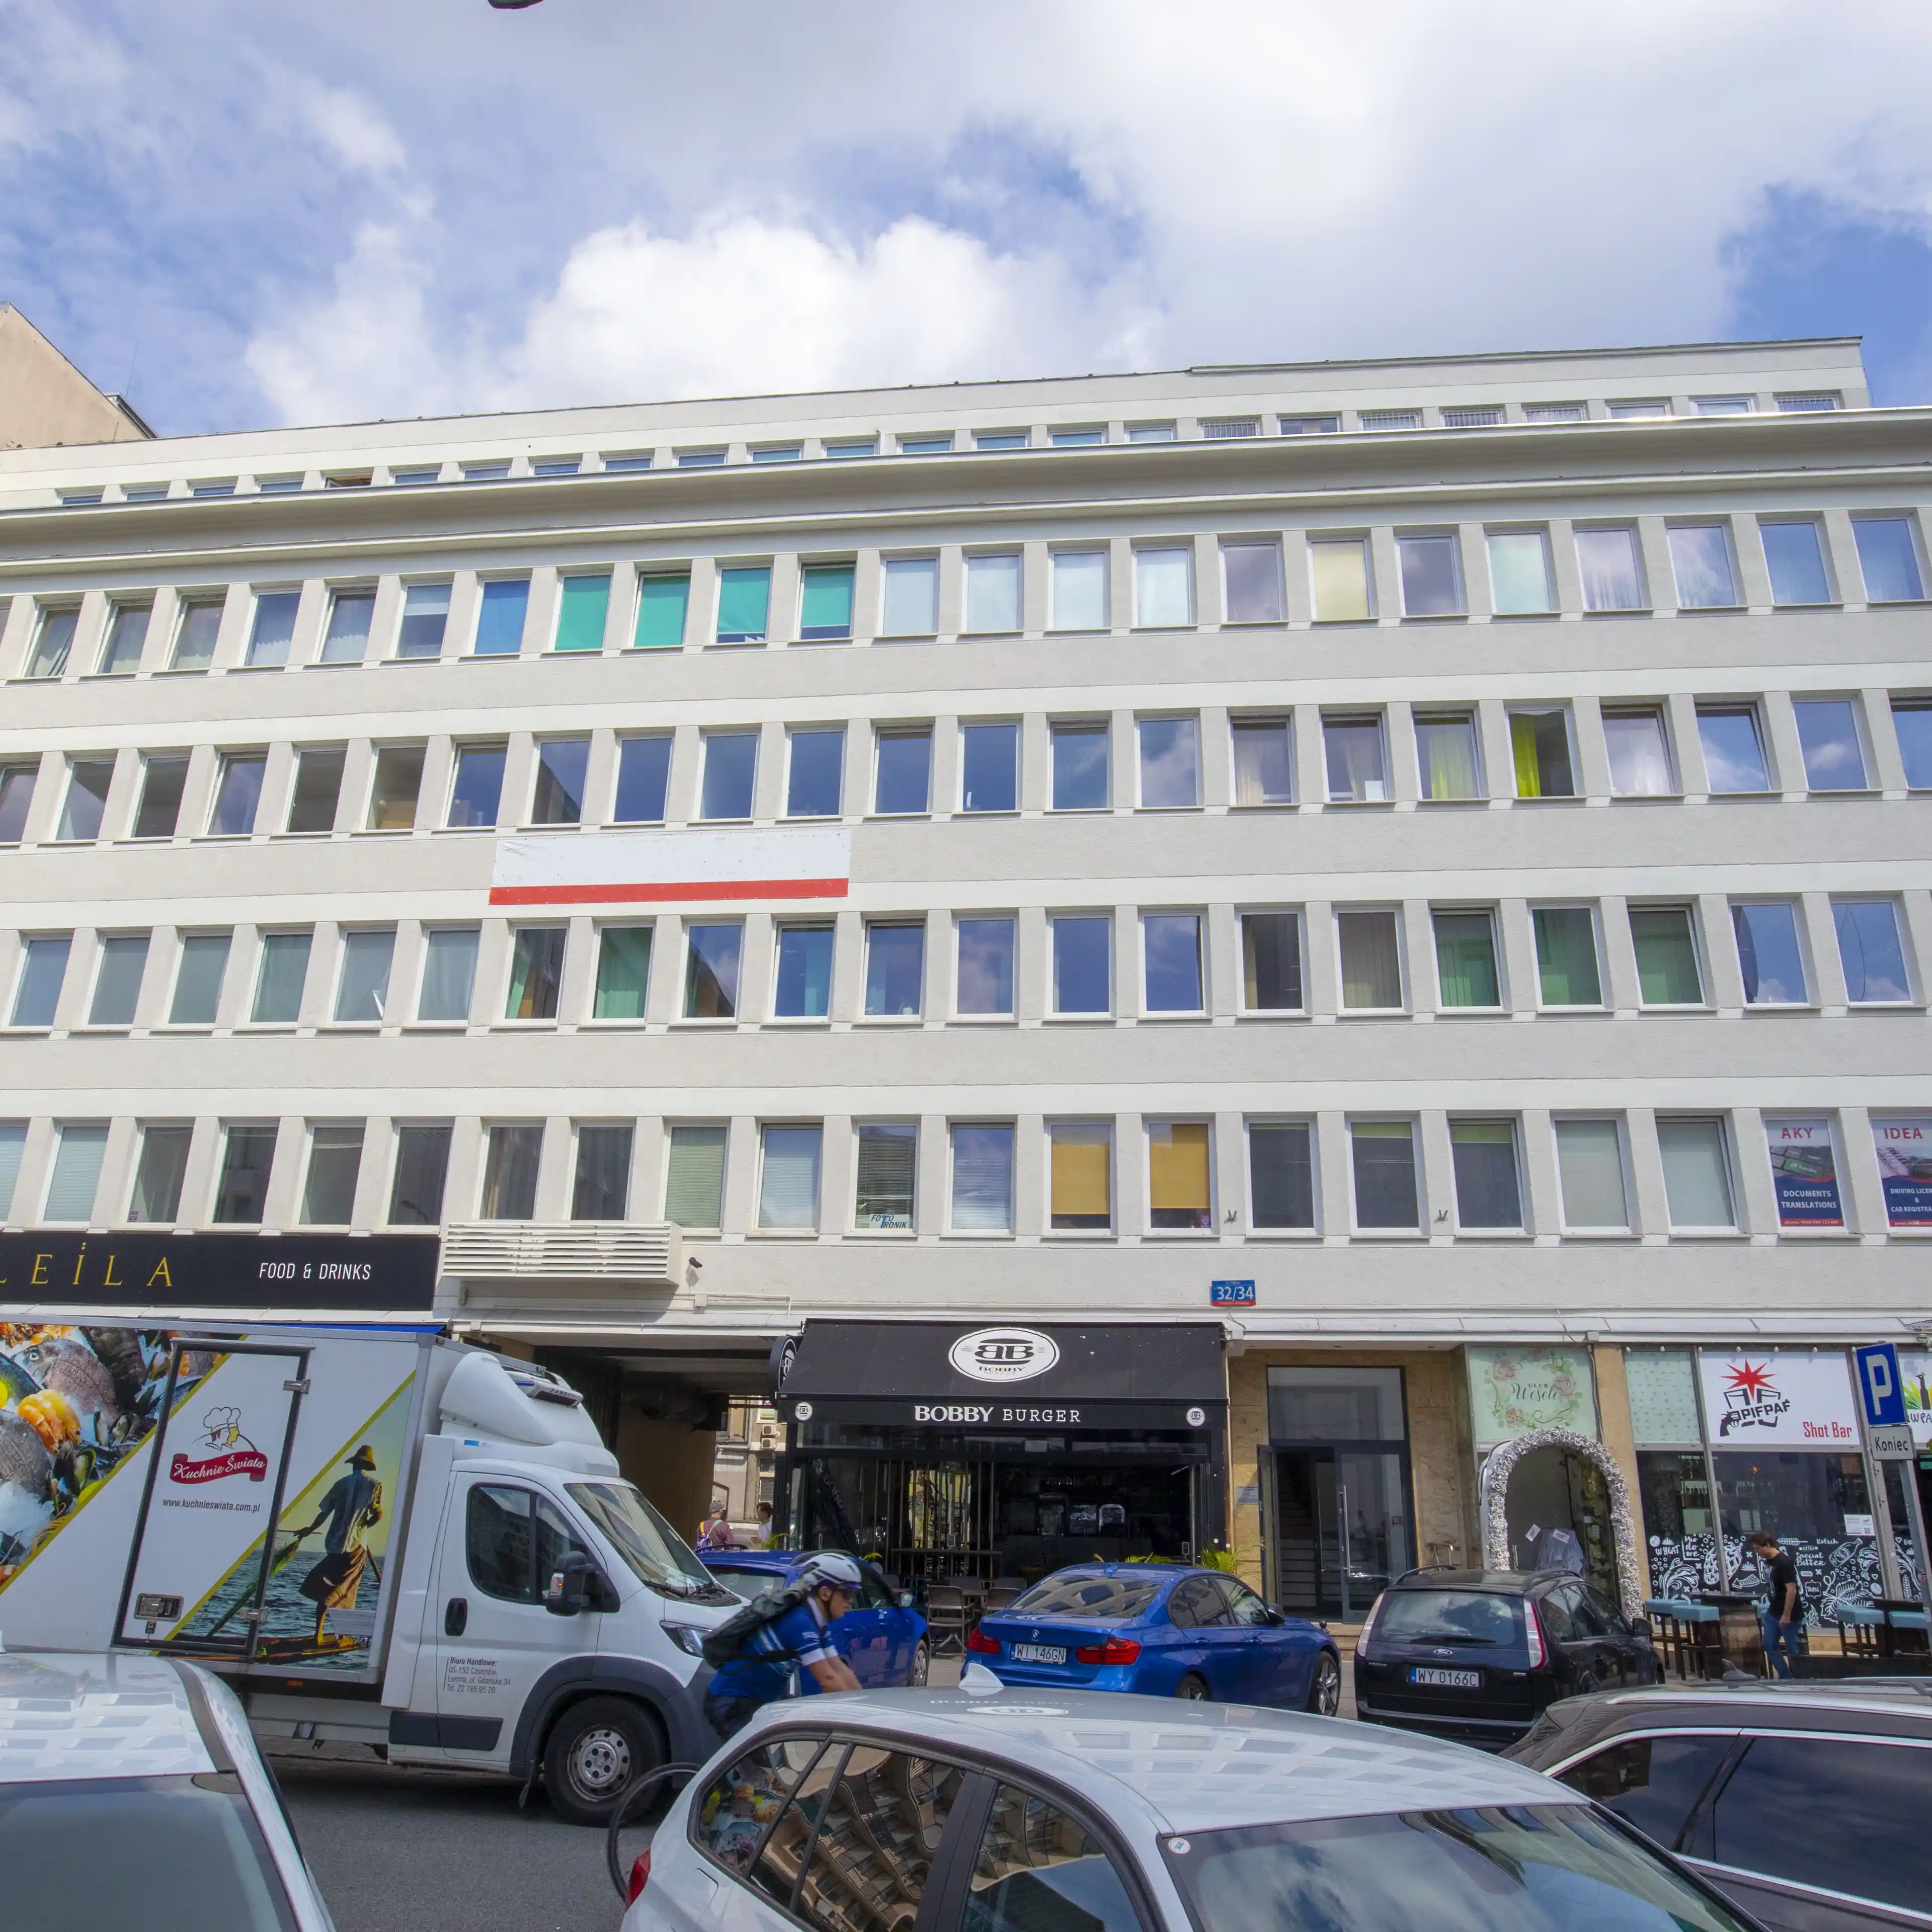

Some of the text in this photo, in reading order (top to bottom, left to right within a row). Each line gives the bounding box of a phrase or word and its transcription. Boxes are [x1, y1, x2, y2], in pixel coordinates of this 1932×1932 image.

[1781, 1128, 1813, 1139] AKY
[1884, 1128, 1923, 1140] IDEA
[259, 1263, 371, 1280] FOOD & DRINKS
[1217, 1286, 1254, 1302] 32/34
[1866, 1354, 1892, 1415] P
[914, 1406, 1081, 1422] BOBBY BURGER
[1803, 1421, 1852, 1437] Shot Bar
[1875, 1436, 1908, 1451] Koniec
[174, 1455, 266, 1479] Kuchnie Świata
[163, 1499, 261, 1513] www.kuchnieswiata.com.pl
[1655, 1545, 1680, 1556] WHEAT
[1796, 1552, 1824, 1562] Special
[1017, 1645, 1065, 1661] WI 146GN
[449, 1666, 469, 1674] 05-152
[1418, 1669, 1477, 1686] WY 0166C
